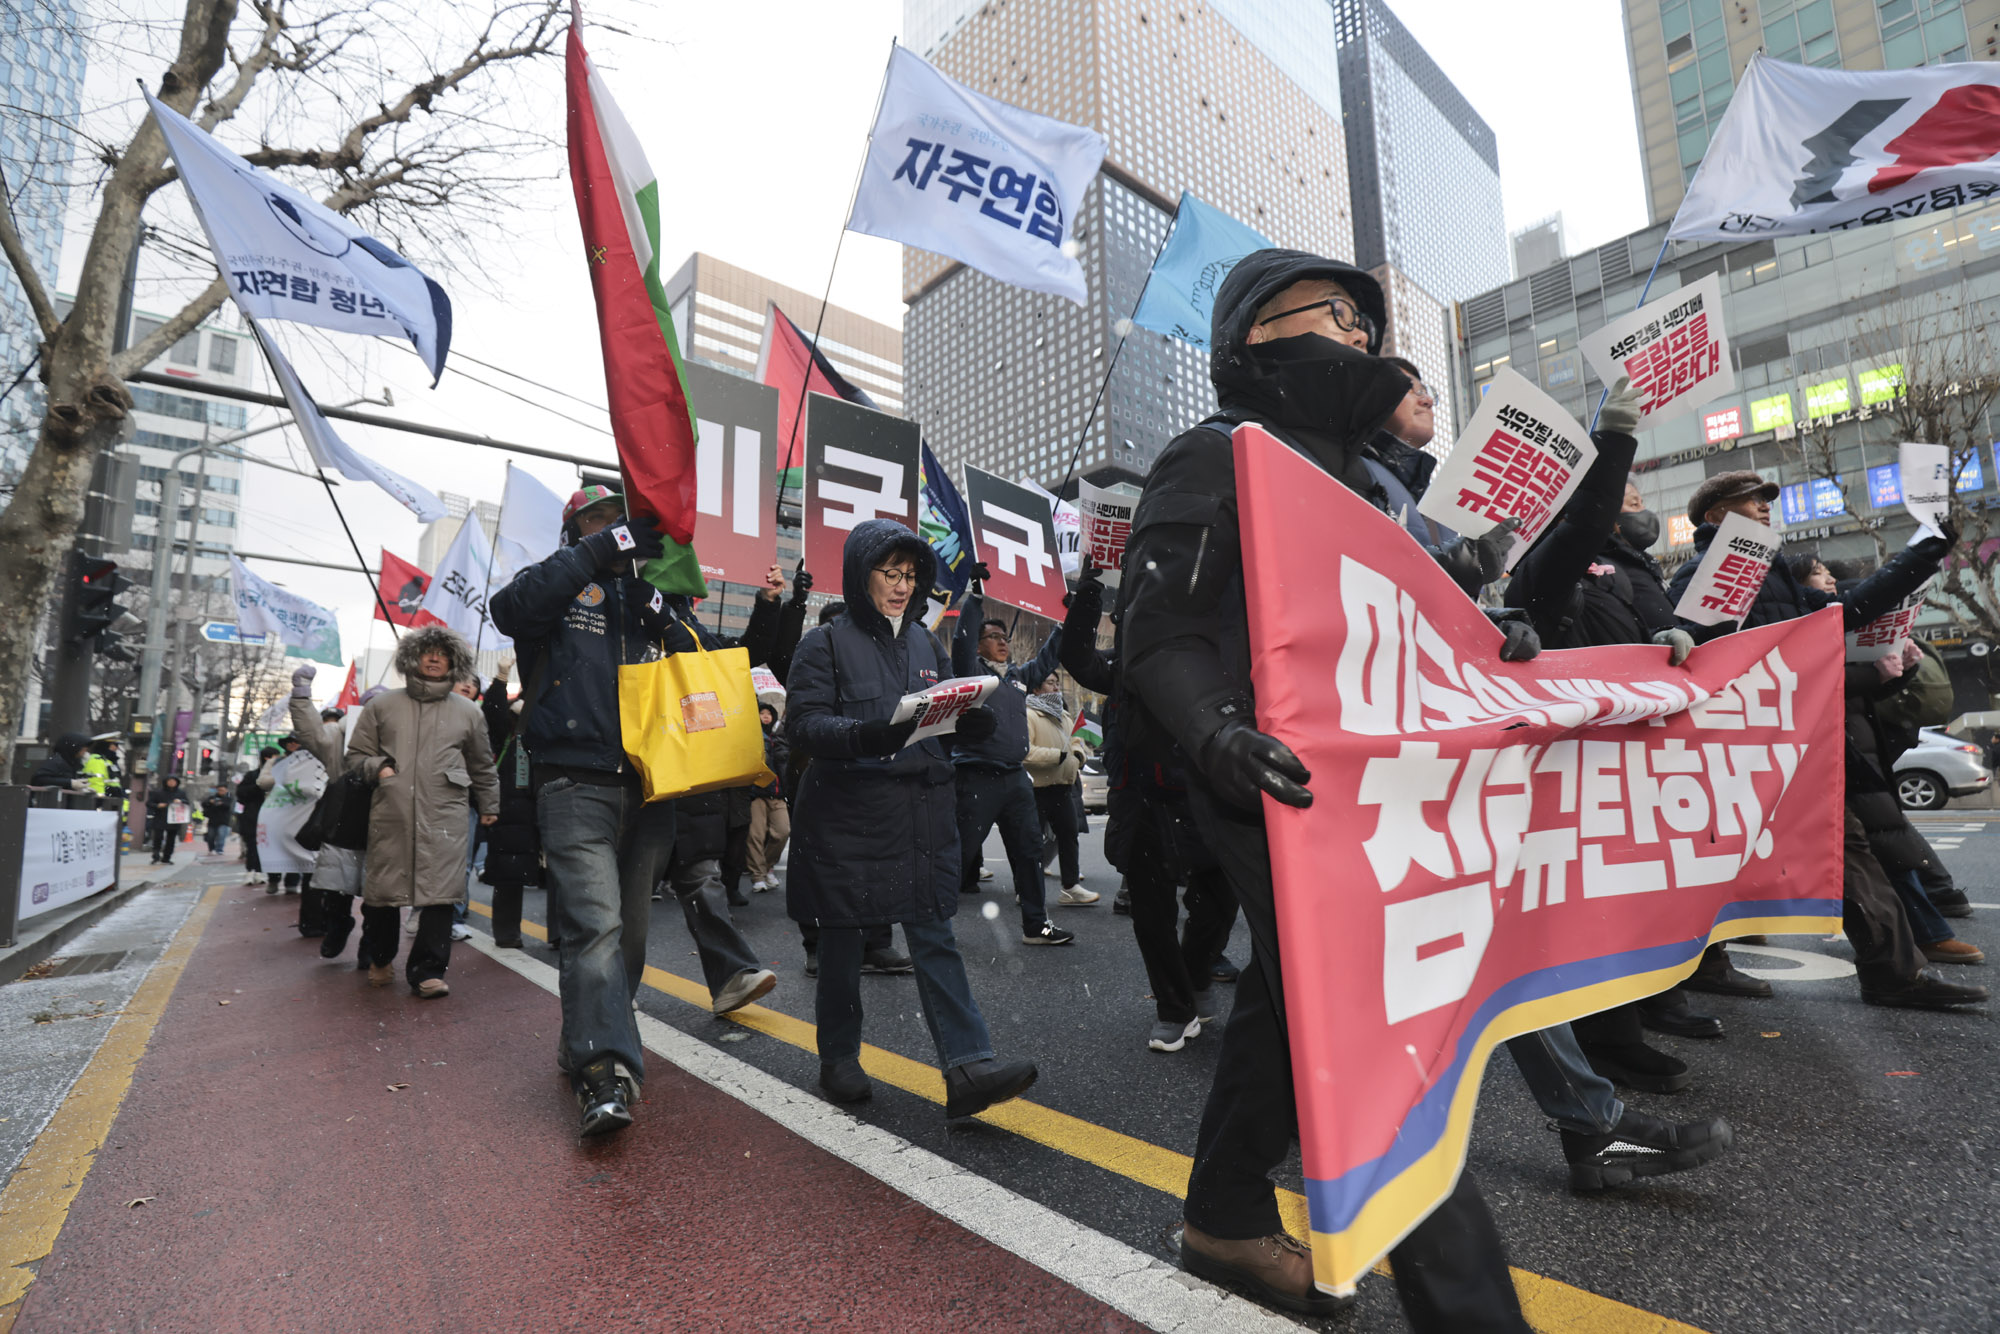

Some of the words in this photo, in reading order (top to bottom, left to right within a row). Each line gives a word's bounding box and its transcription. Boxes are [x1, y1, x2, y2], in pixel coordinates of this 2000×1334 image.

[892, 137, 1064, 249] 자주연합
[1610, 319, 1663, 361] 석유강탈
[1662, 293, 1704, 330] 식민지배
[1624, 312, 1709, 388] 트럼프를
[1496, 404, 1554, 447] 석유강탈
[1669, 446, 1719, 465] STUDIO
[1473, 428, 1571, 506] 트럼프를
[981, 500, 1054, 588] 규
[1096, 503, 1132, 521] 식민지배
[681, 692, 717, 706] SUNRISE
